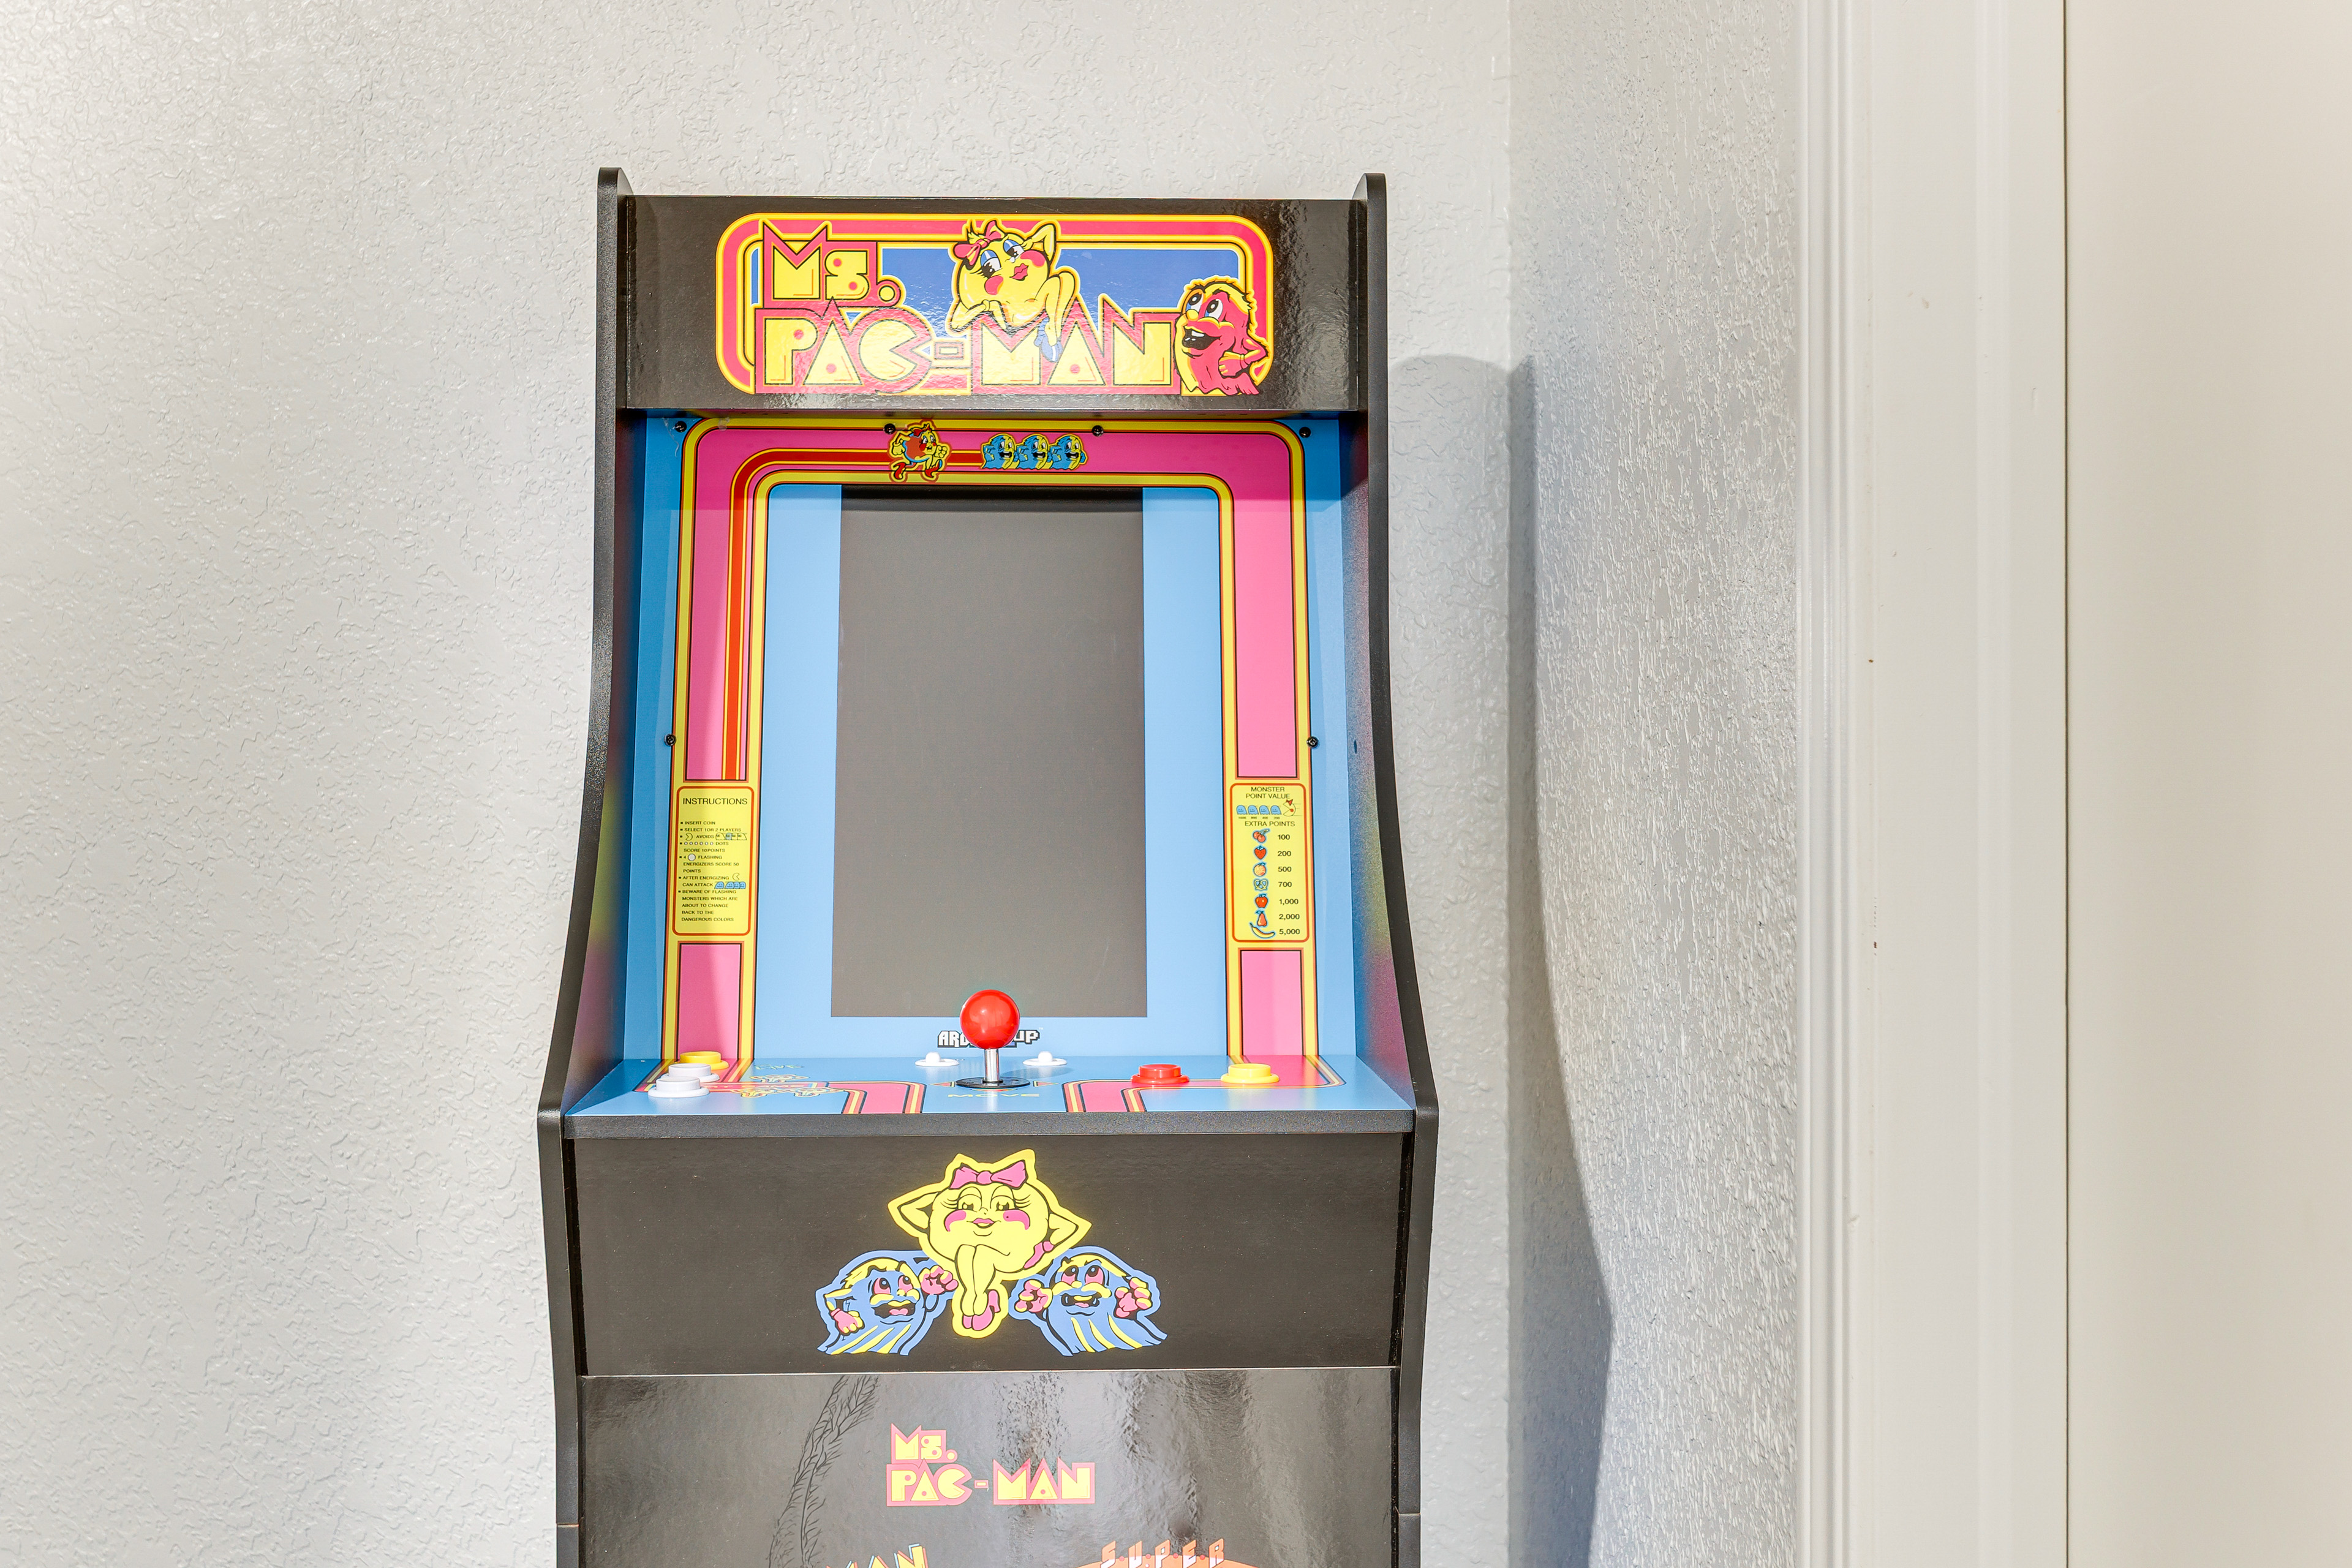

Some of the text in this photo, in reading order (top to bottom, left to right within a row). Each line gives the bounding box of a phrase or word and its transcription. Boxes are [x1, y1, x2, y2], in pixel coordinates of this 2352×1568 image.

[763, 223, 901, 306] Ms.
[755, 299, 1181, 394] PAC-MAN
[891, 1423, 958, 1463] Ms.
[886, 1458, 1095, 1506] PAC-MAN
